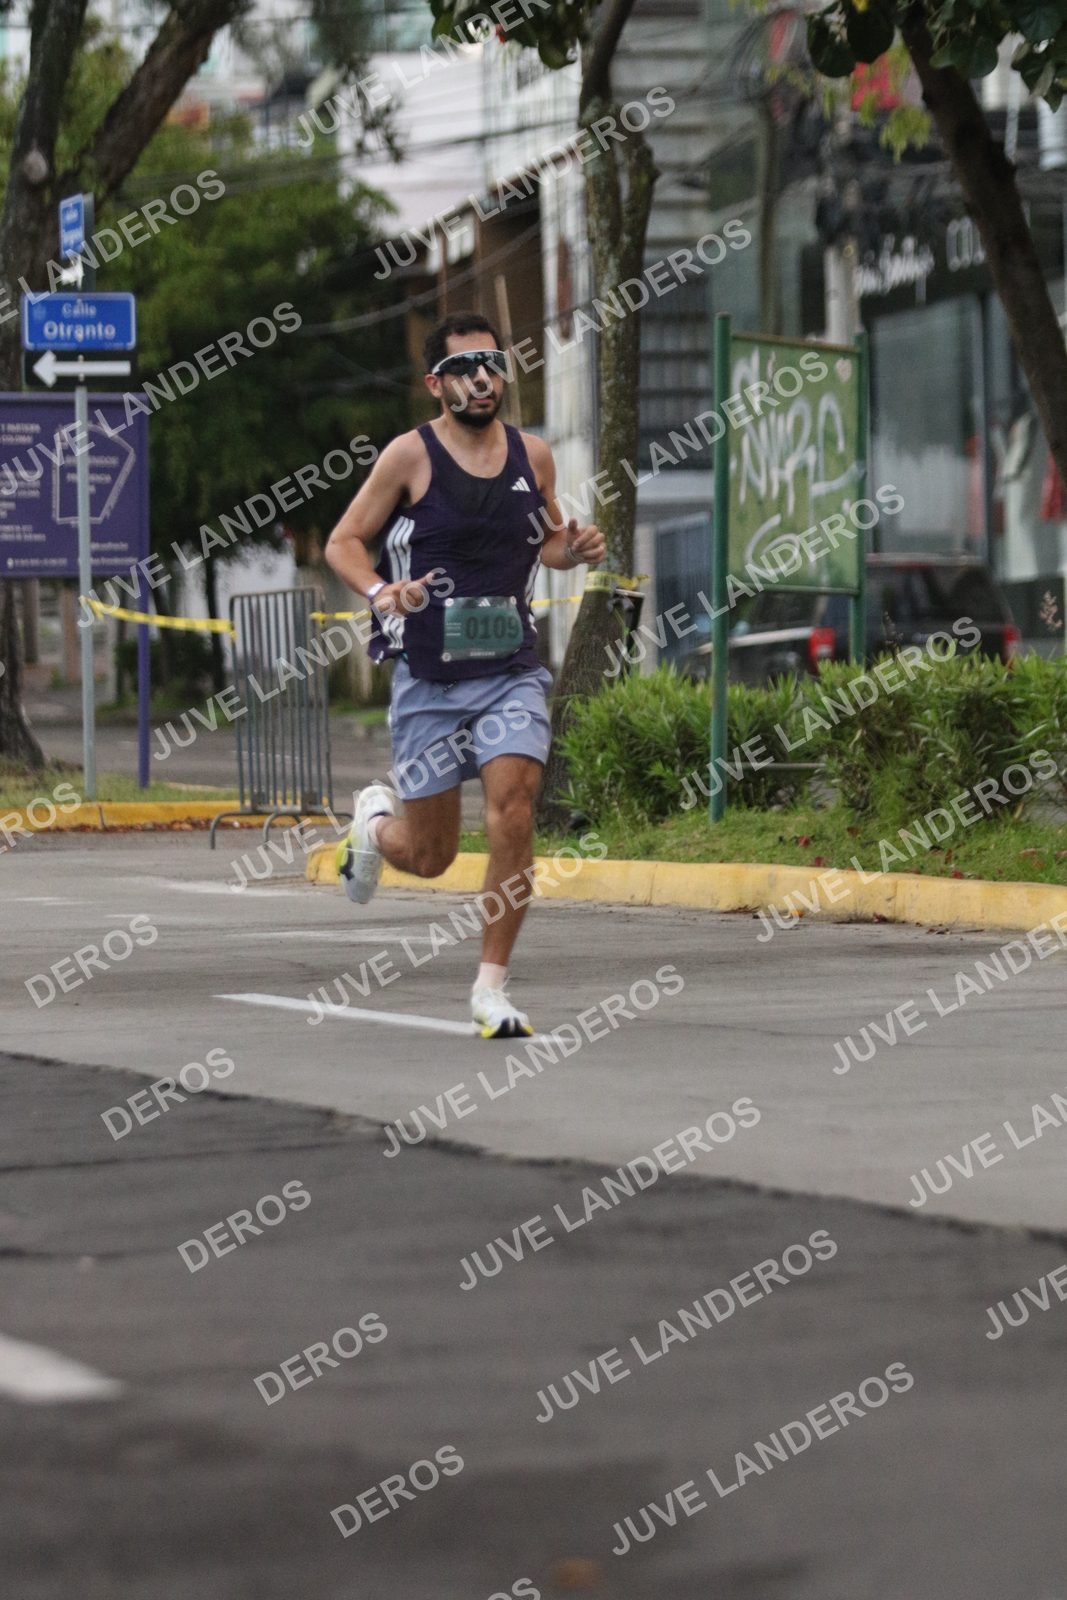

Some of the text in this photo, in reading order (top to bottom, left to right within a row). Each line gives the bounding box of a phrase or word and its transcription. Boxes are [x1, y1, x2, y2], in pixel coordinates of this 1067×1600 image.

[62, 301, 97, 316] Calle
[43, 320, 116, 338] Otranto
[465, 616, 520, 640] 0109
